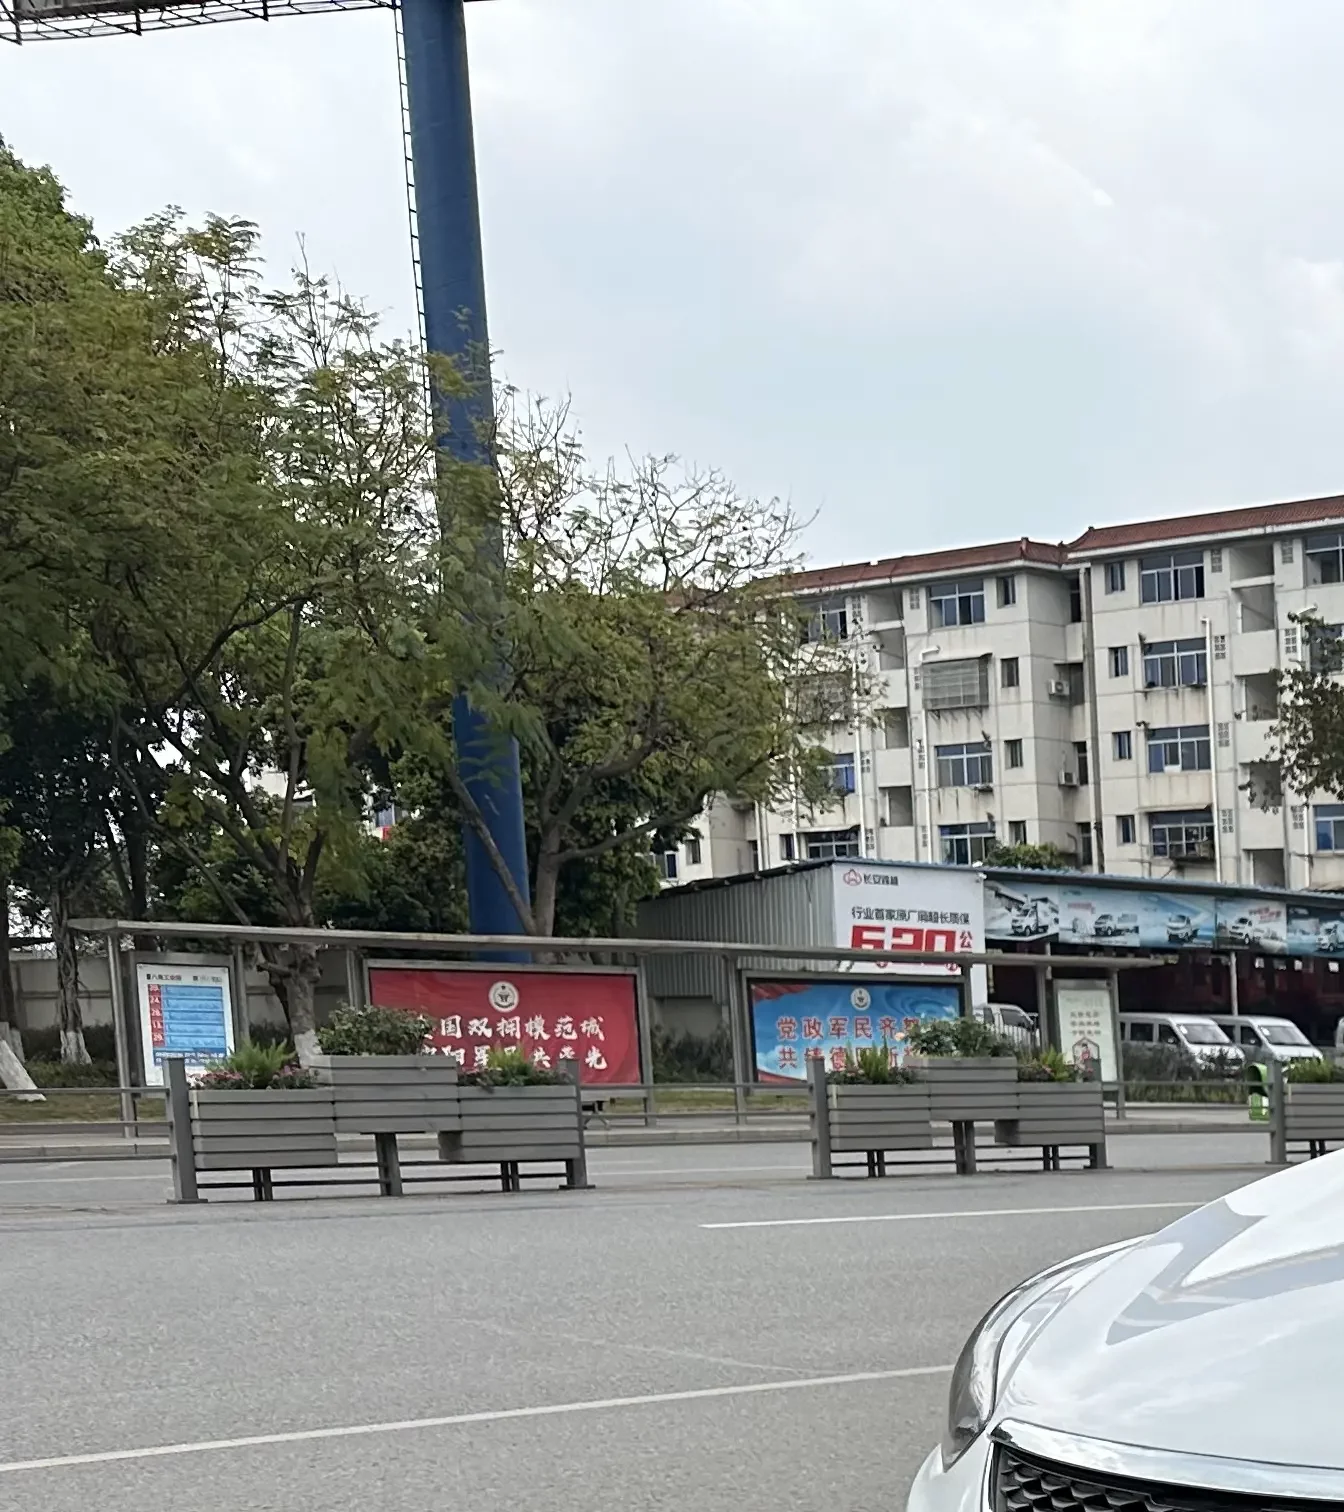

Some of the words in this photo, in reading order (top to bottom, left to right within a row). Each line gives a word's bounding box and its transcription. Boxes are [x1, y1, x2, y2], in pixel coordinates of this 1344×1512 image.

[421, 1014, 605, 1041] 国双拥模范城
